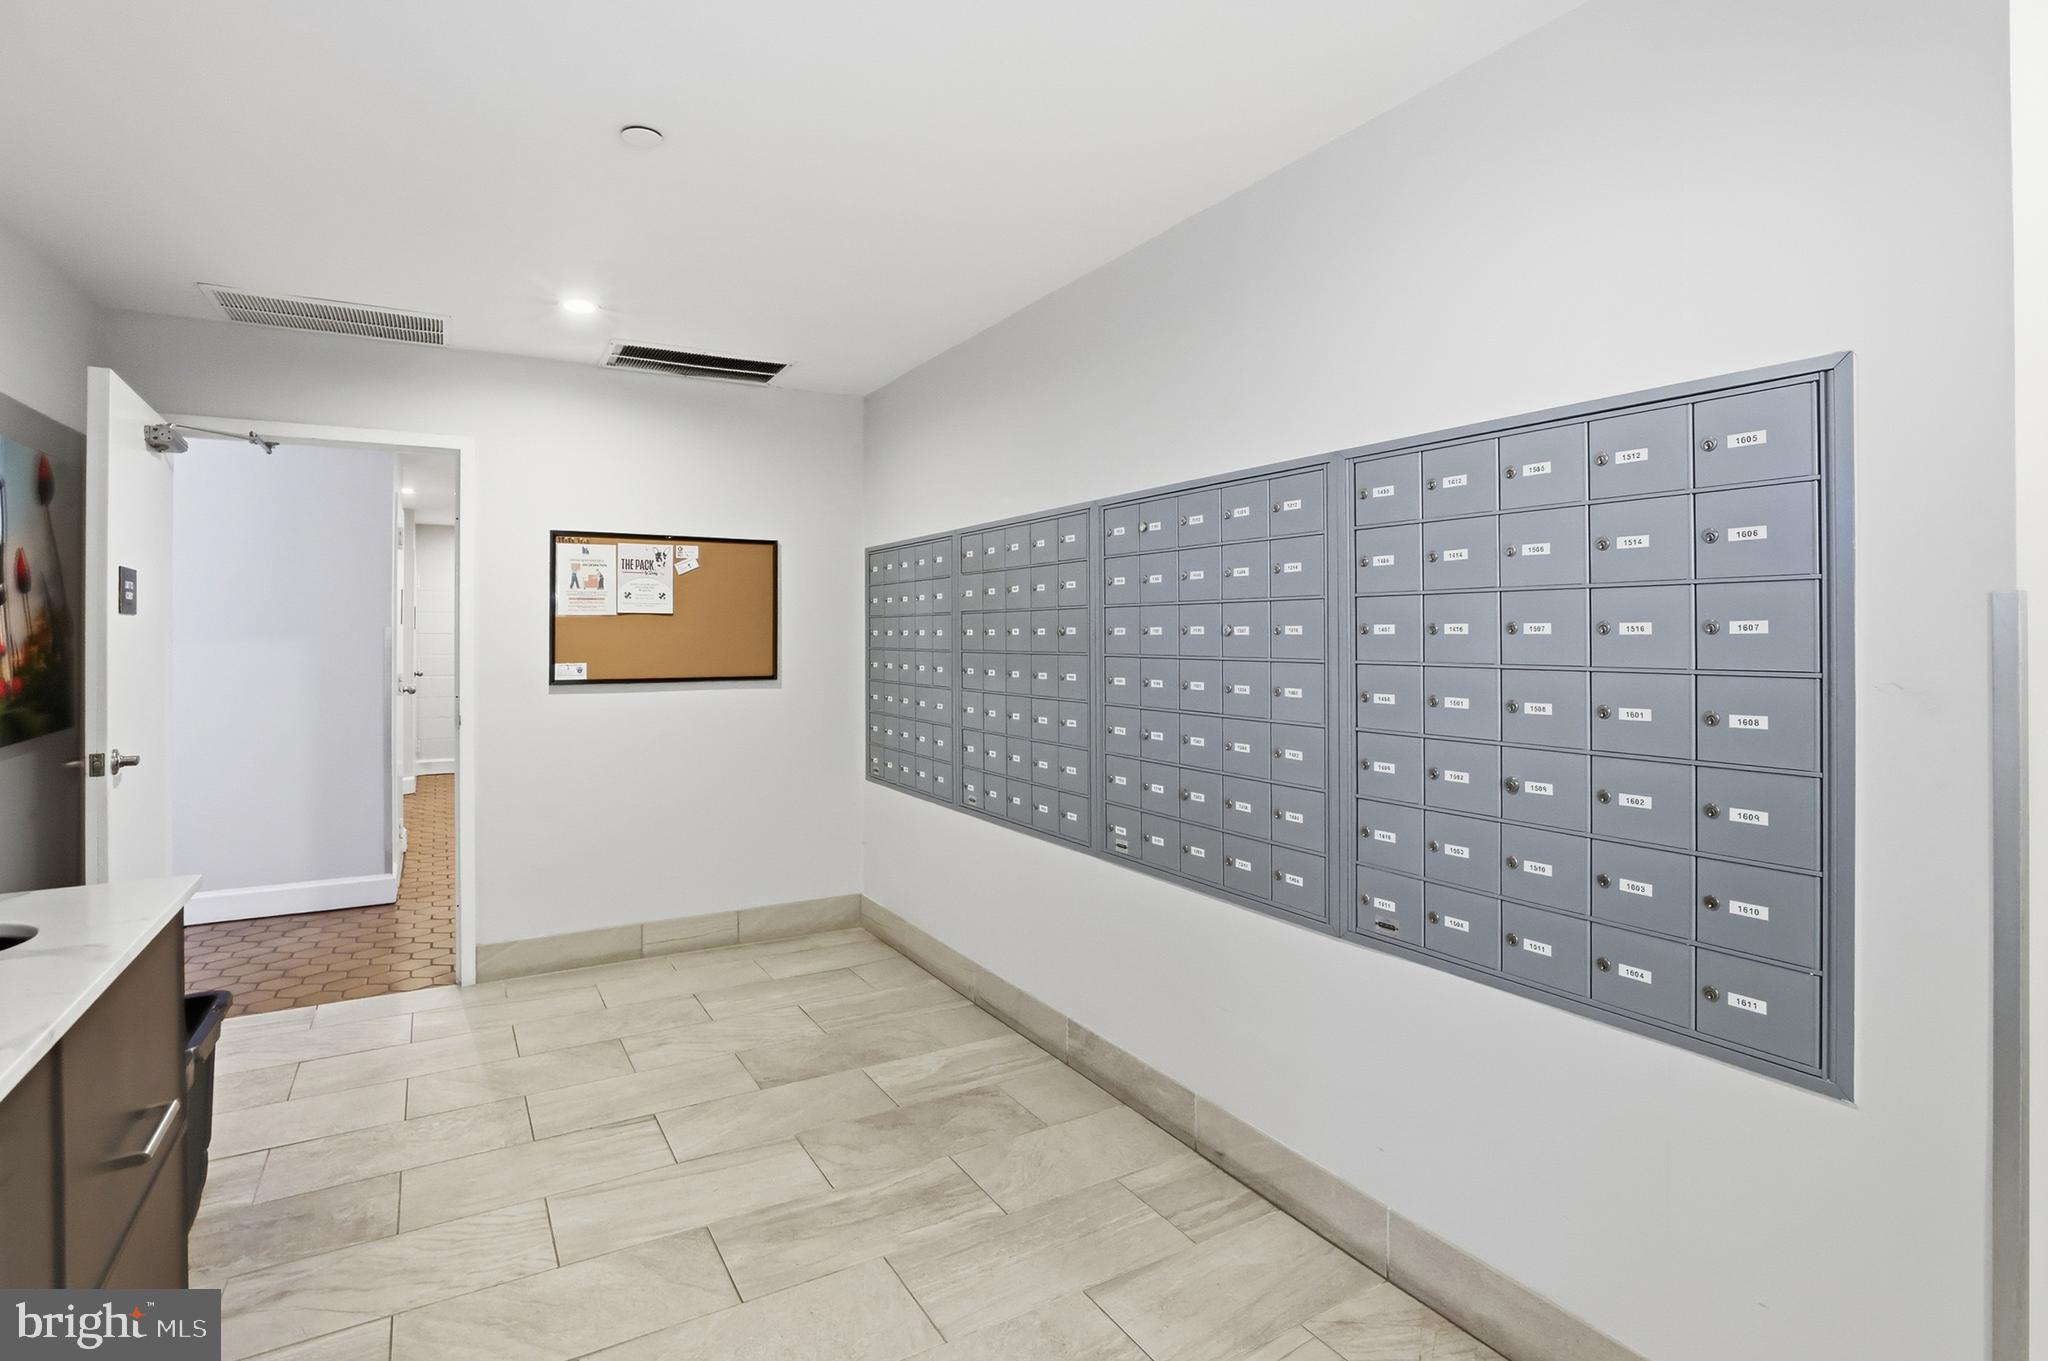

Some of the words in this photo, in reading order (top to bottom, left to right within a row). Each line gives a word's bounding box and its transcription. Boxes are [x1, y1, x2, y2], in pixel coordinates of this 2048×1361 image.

[1735, 434, 1758, 445] 1605
[1622, 452, 1641, 461] 1512
[1447, 477, 1462, 487] 1412
[1736, 529, 1759, 538] 1606
[1623, 538, 1643, 546] 1514
[1528, 545, 1545, 553] 1506
[1448, 551, 1463, 559] 1414
[621, 558, 634, 570] THE
[635, 559, 654, 571] PACK
[1529, 625, 1545, 633] 1507
[1626, 625, 1645, 633] 1516
[1738, 623, 1760, 632] 1607
[1626, 711, 1644, 719] 1601
[1737, 718, 1760, 727] 1608
[1530, 784, 1548, 793] 1509
[1626, 797, 1645, 806] 1602
[1737, 812, 1760, 822] 1609
[1529, 864, 1546, 873] 1510
[1626, 883, 1646, 893] 1603
[1738, 905, 1760, 916] 1610
[1625, 968, 1645, 979] 1604
[1736, 998, 1757, 1009] 1611
